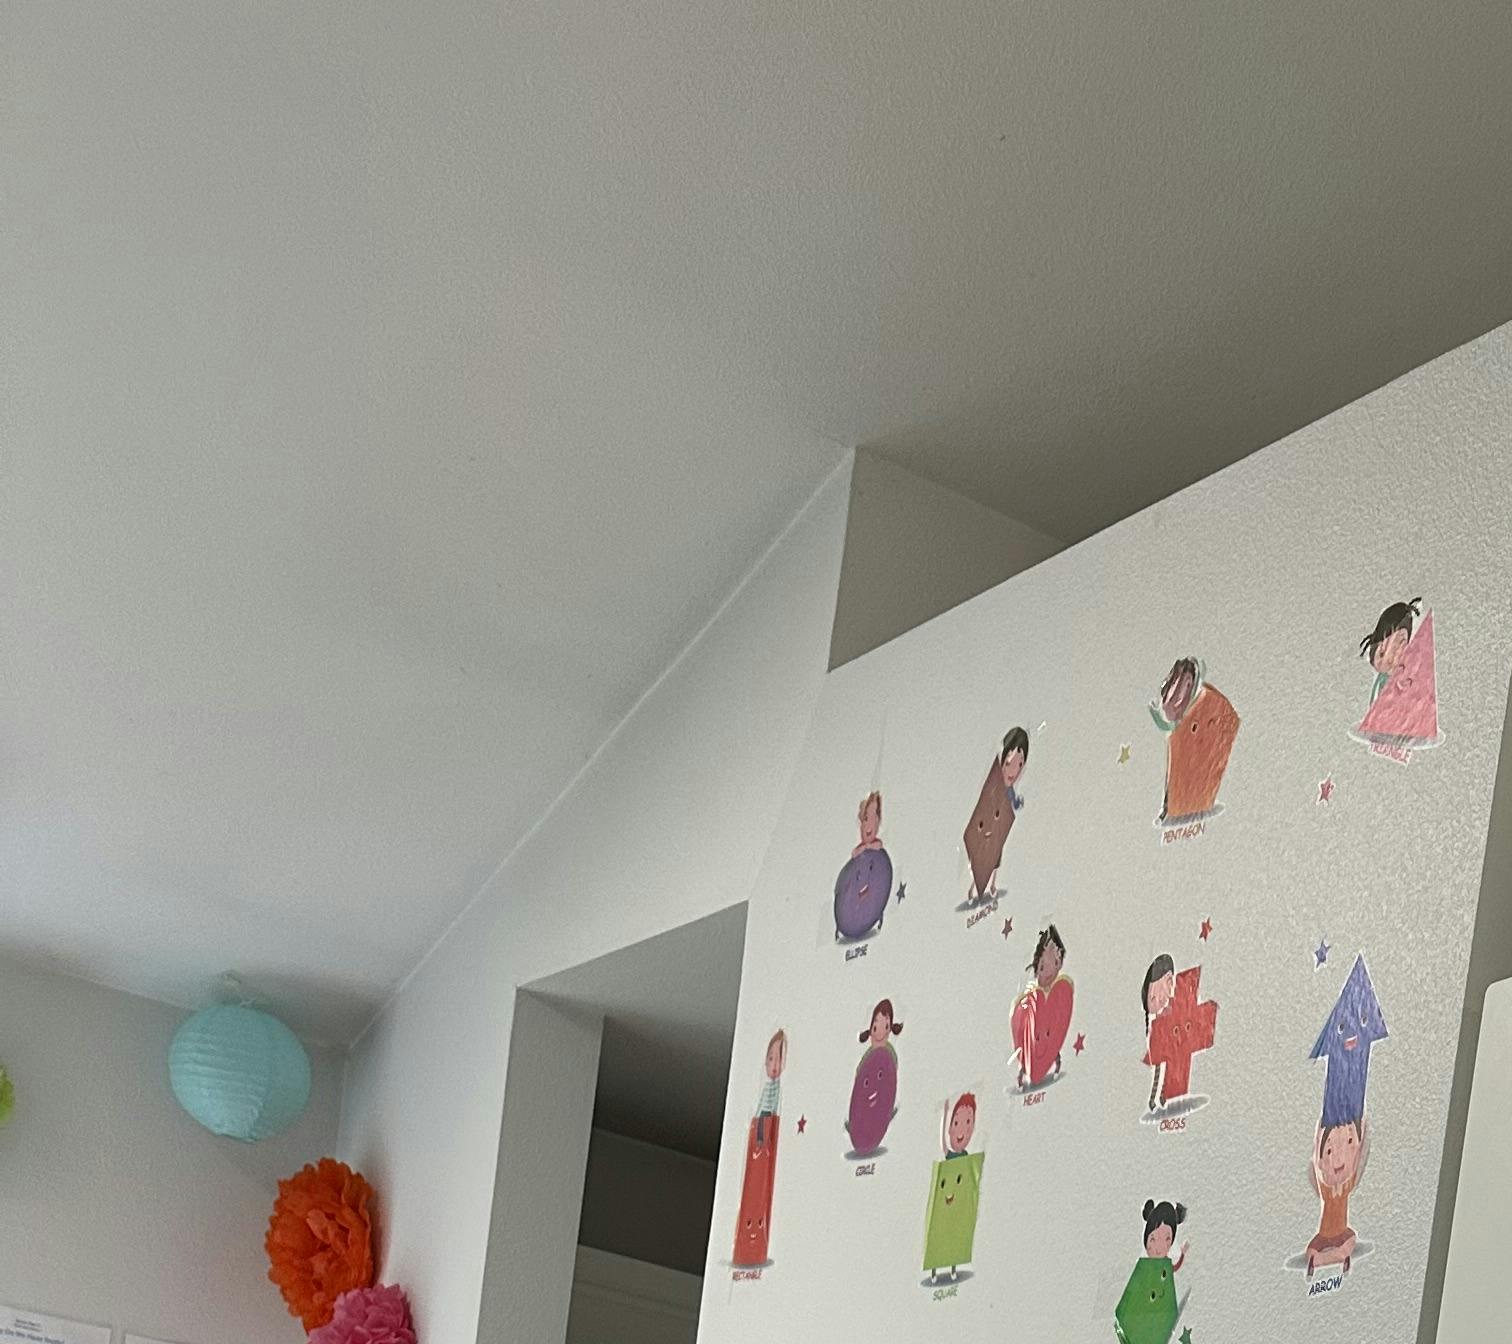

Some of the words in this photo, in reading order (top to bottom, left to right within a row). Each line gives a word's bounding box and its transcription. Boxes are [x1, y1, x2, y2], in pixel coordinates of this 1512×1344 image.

[1164, 823, 1205, 843] PENTAGON
[1024, 1092, 1046, 1106] HEART
[1160, 1118, 1186, 1131] CROSS
[1308, 1275, 1343, 1296] ARROW
